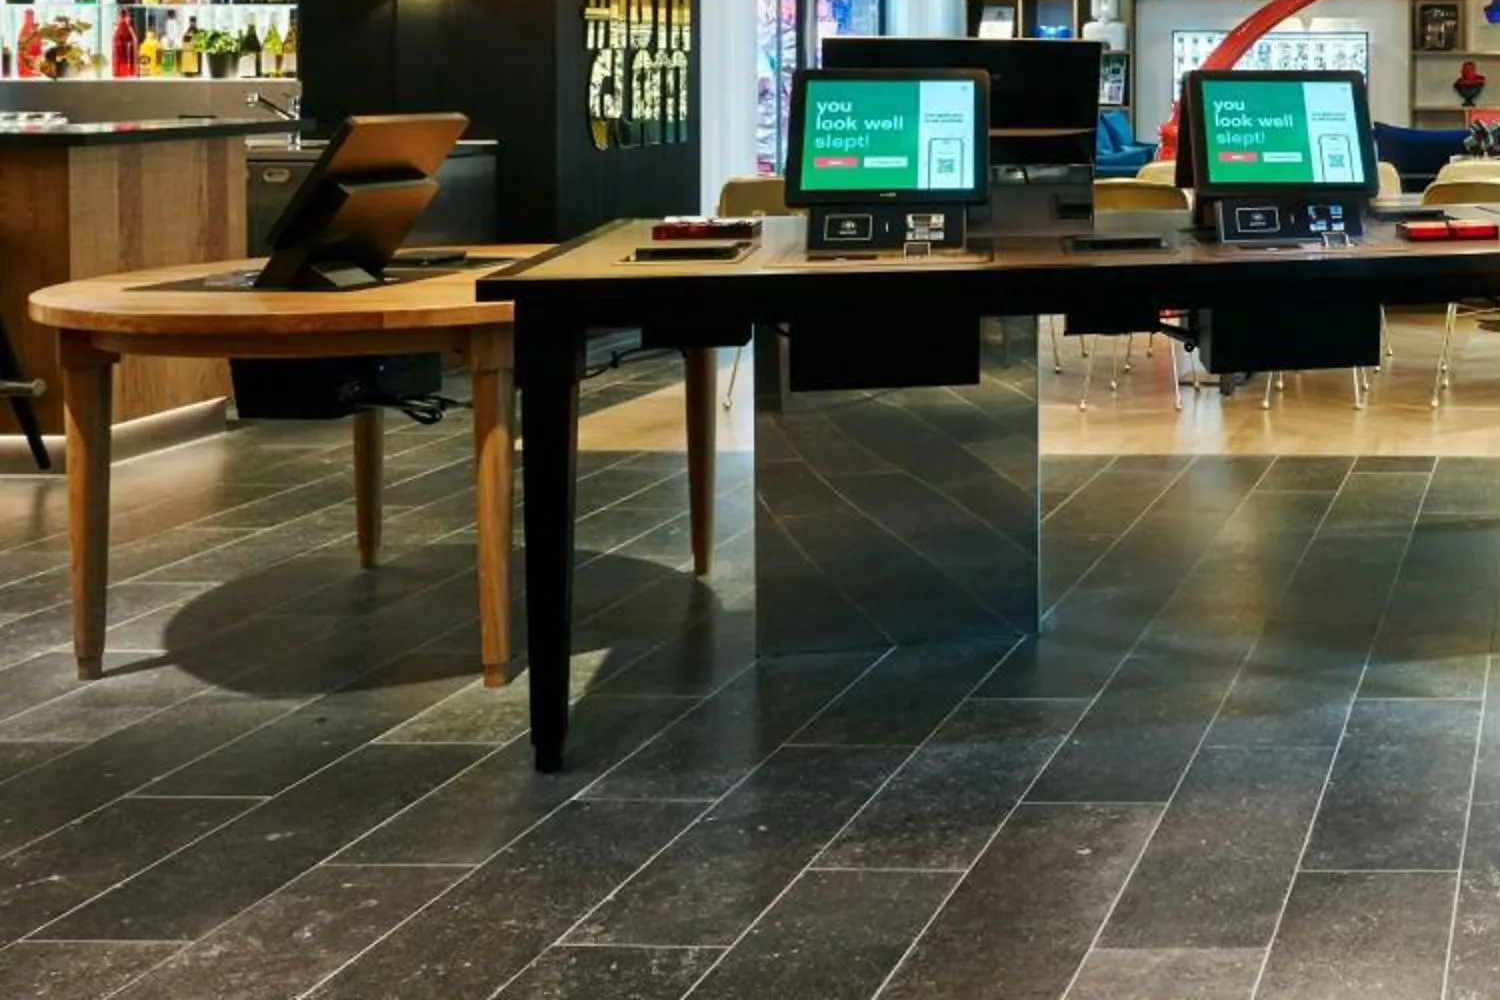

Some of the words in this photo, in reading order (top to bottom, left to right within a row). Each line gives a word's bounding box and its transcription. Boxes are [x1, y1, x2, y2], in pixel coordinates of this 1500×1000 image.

[816, 101, 852, 115] you
[1213, 100, 1245, 113] you
[816, 113, 858, 131] look
[863, 114, 904, 131] well
[1214, 111, 1253, 127] look
[1257, 113, 1294, 128] well
[815, 133, 870, 152] slept!
